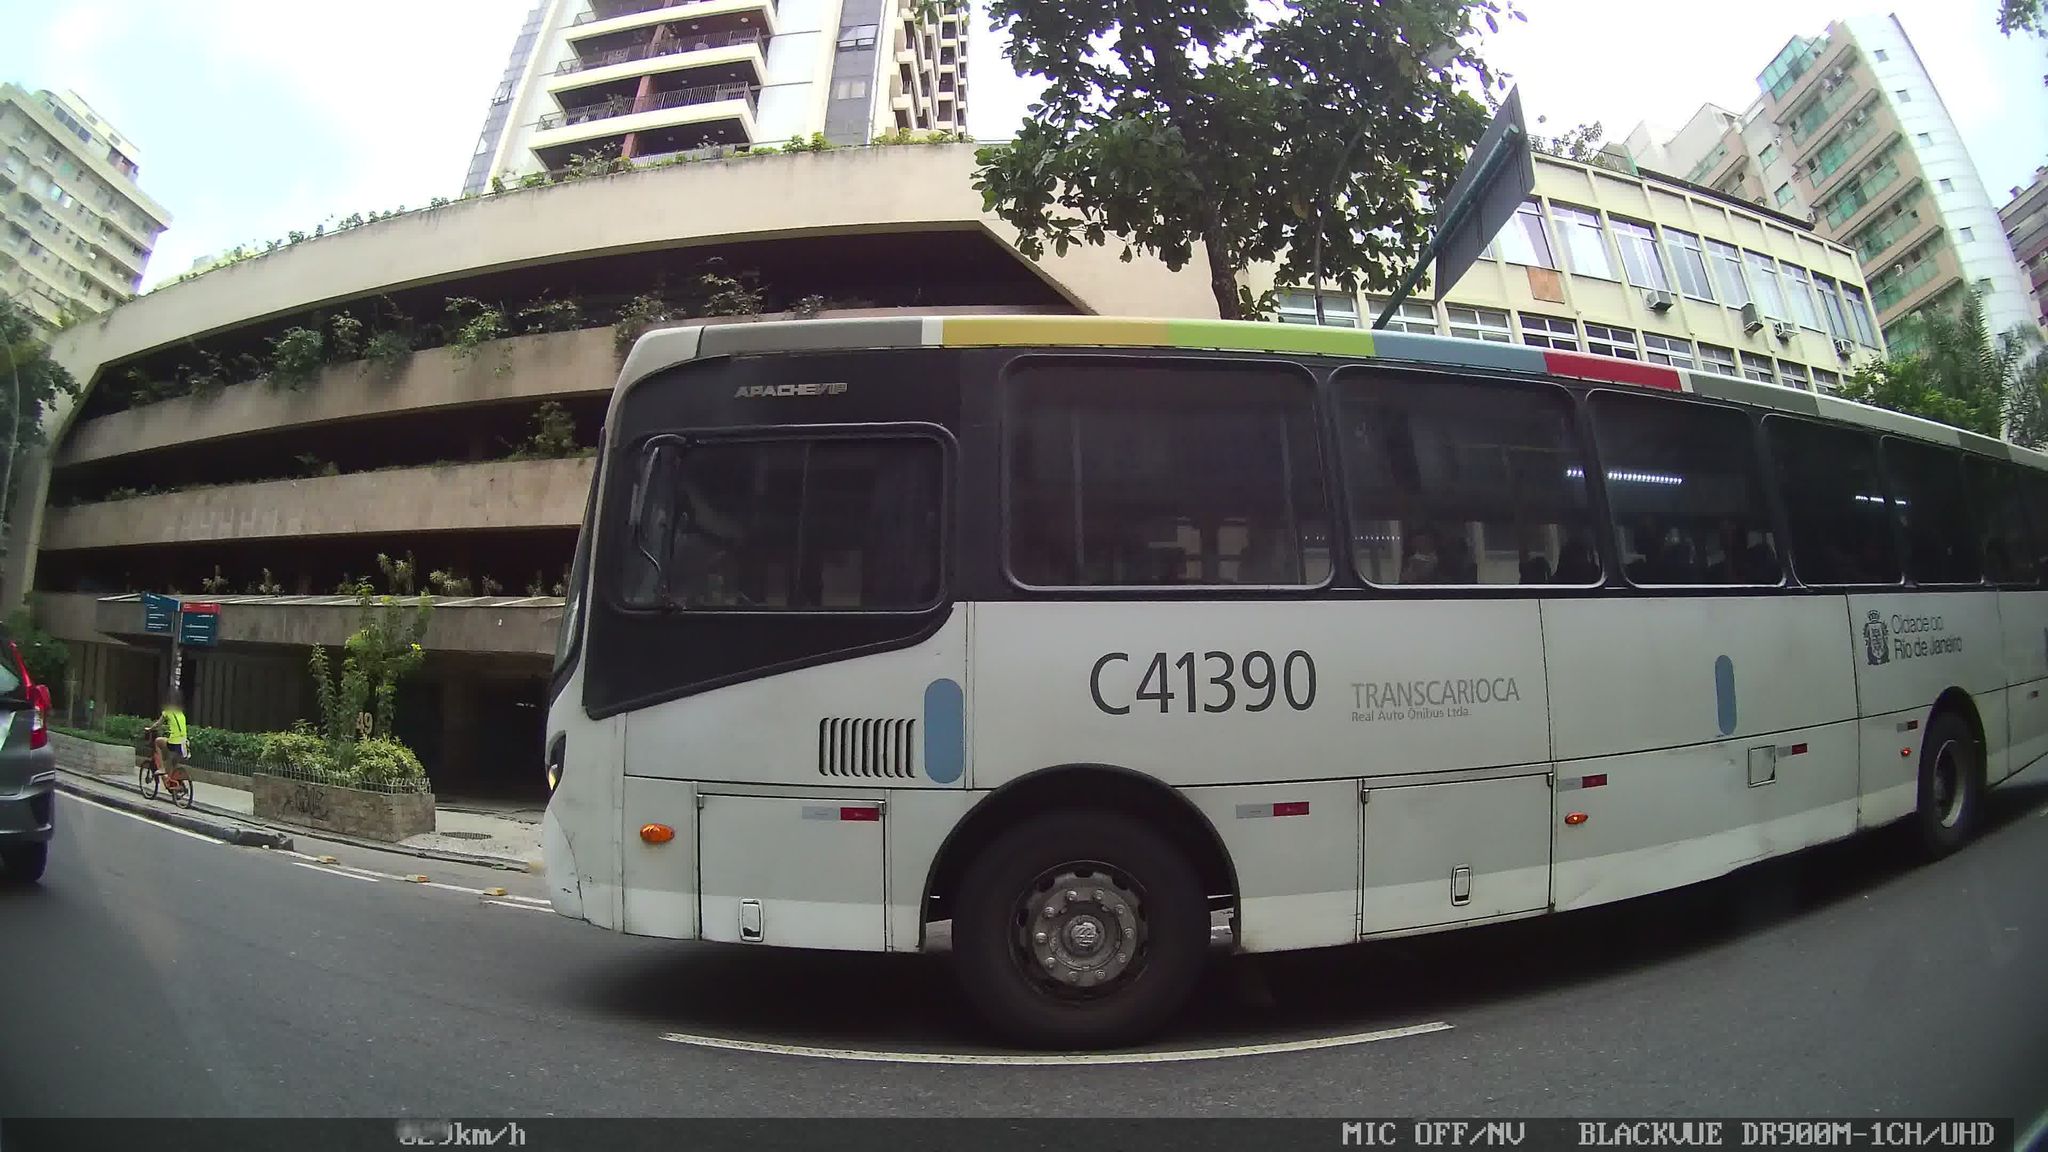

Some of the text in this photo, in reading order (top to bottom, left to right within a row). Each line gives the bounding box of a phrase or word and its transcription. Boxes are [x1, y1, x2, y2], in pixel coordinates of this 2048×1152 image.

[1891, 613, 1929, 634] Cidade
[1894, 634, 1963, 659] Rio de Janeiro
[1089, 649, 1317, 715] C41390
[1351, 677, 1521, 709] TRANSCARIOCA
[1351, 710, 1374, 723] Real
[1377, 709, 1405, 722] Auto
